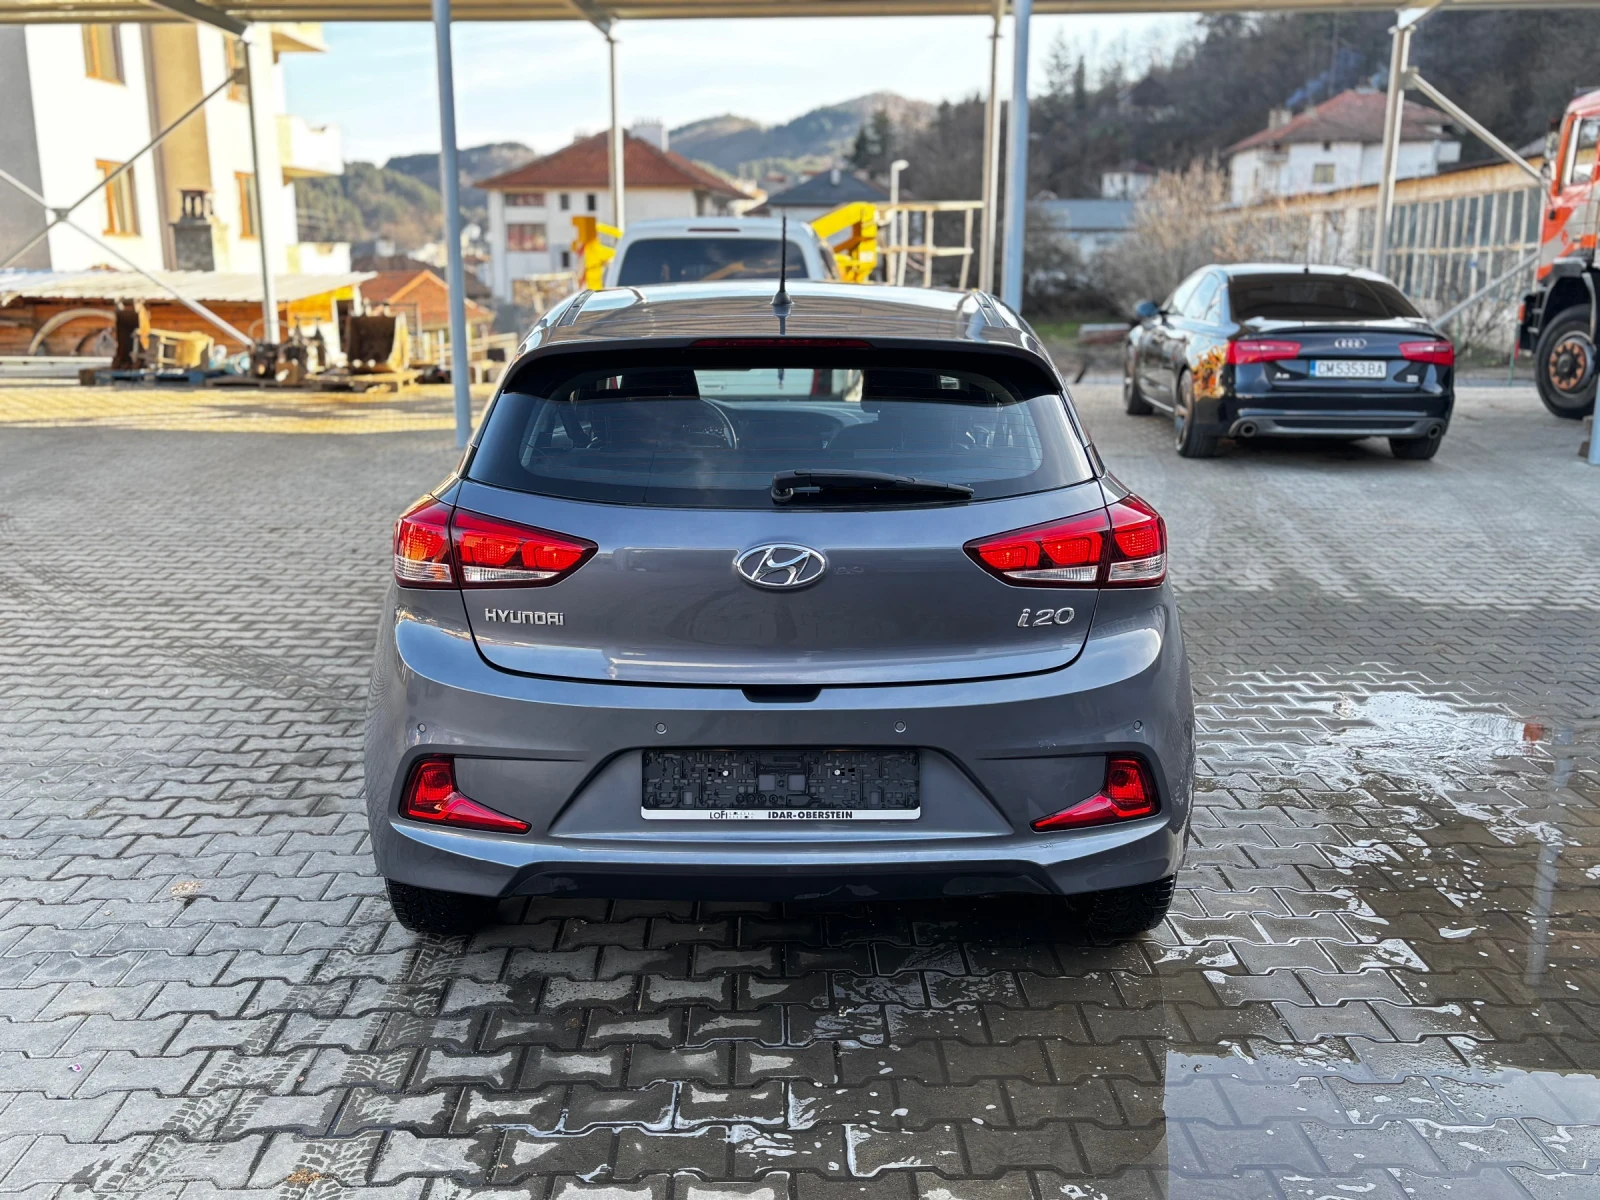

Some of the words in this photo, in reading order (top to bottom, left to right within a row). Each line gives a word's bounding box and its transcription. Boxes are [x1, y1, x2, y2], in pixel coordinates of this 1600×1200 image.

[484, 608, 564, 626] HYUNDAI
[1017, 607, 1075, 627] i20
[767, 811, 853, 819] IDAR-OBERSTEIN
